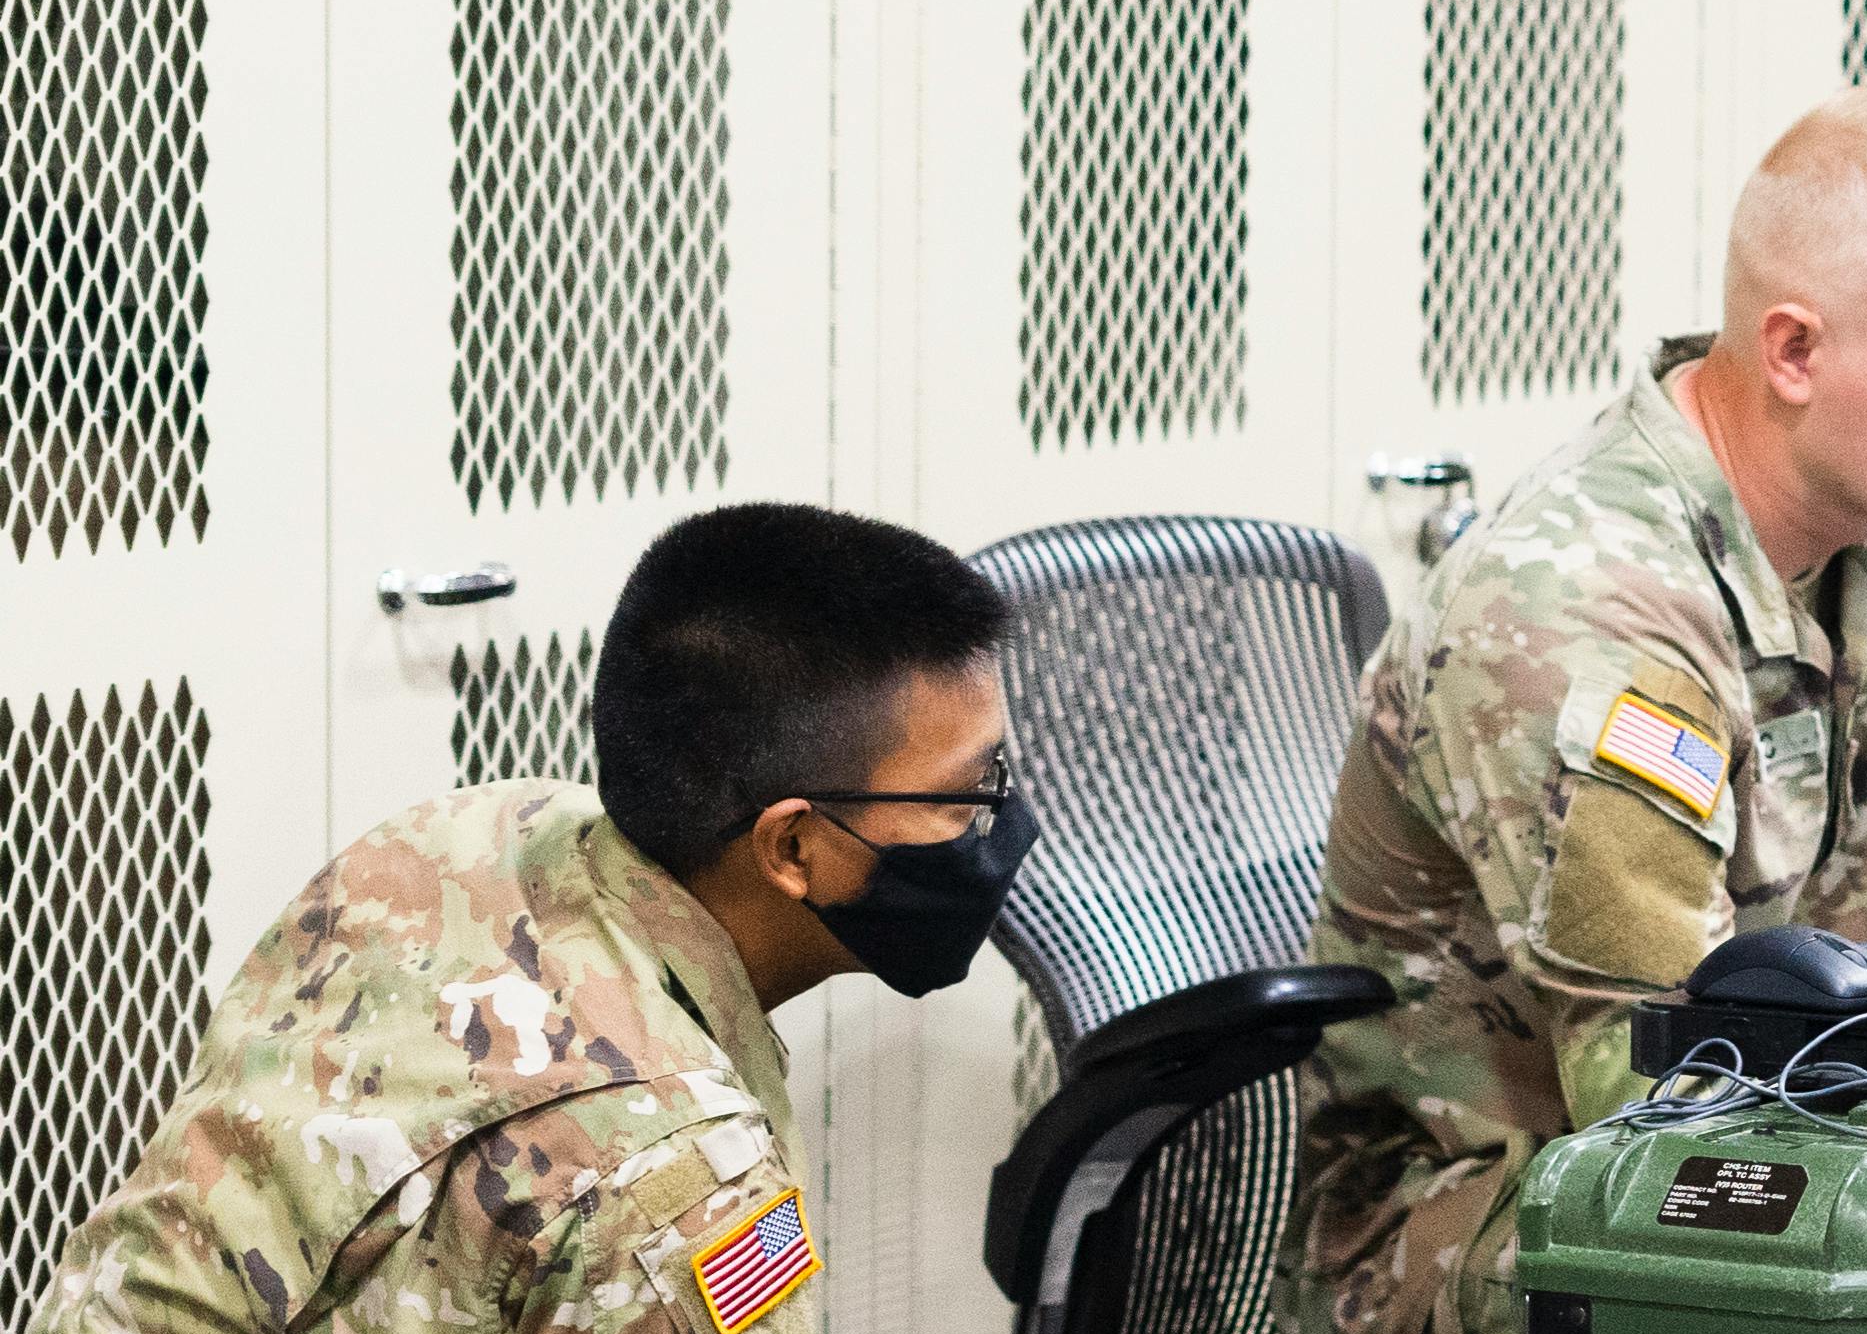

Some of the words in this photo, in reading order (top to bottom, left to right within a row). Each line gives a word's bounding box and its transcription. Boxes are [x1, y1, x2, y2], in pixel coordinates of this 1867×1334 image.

[1750, 1164, 1772, 1173] ITEM
[1748, 1172, 1771, 1180] ASSY
[1730, 1181, 1764, 1191] ROUTER
